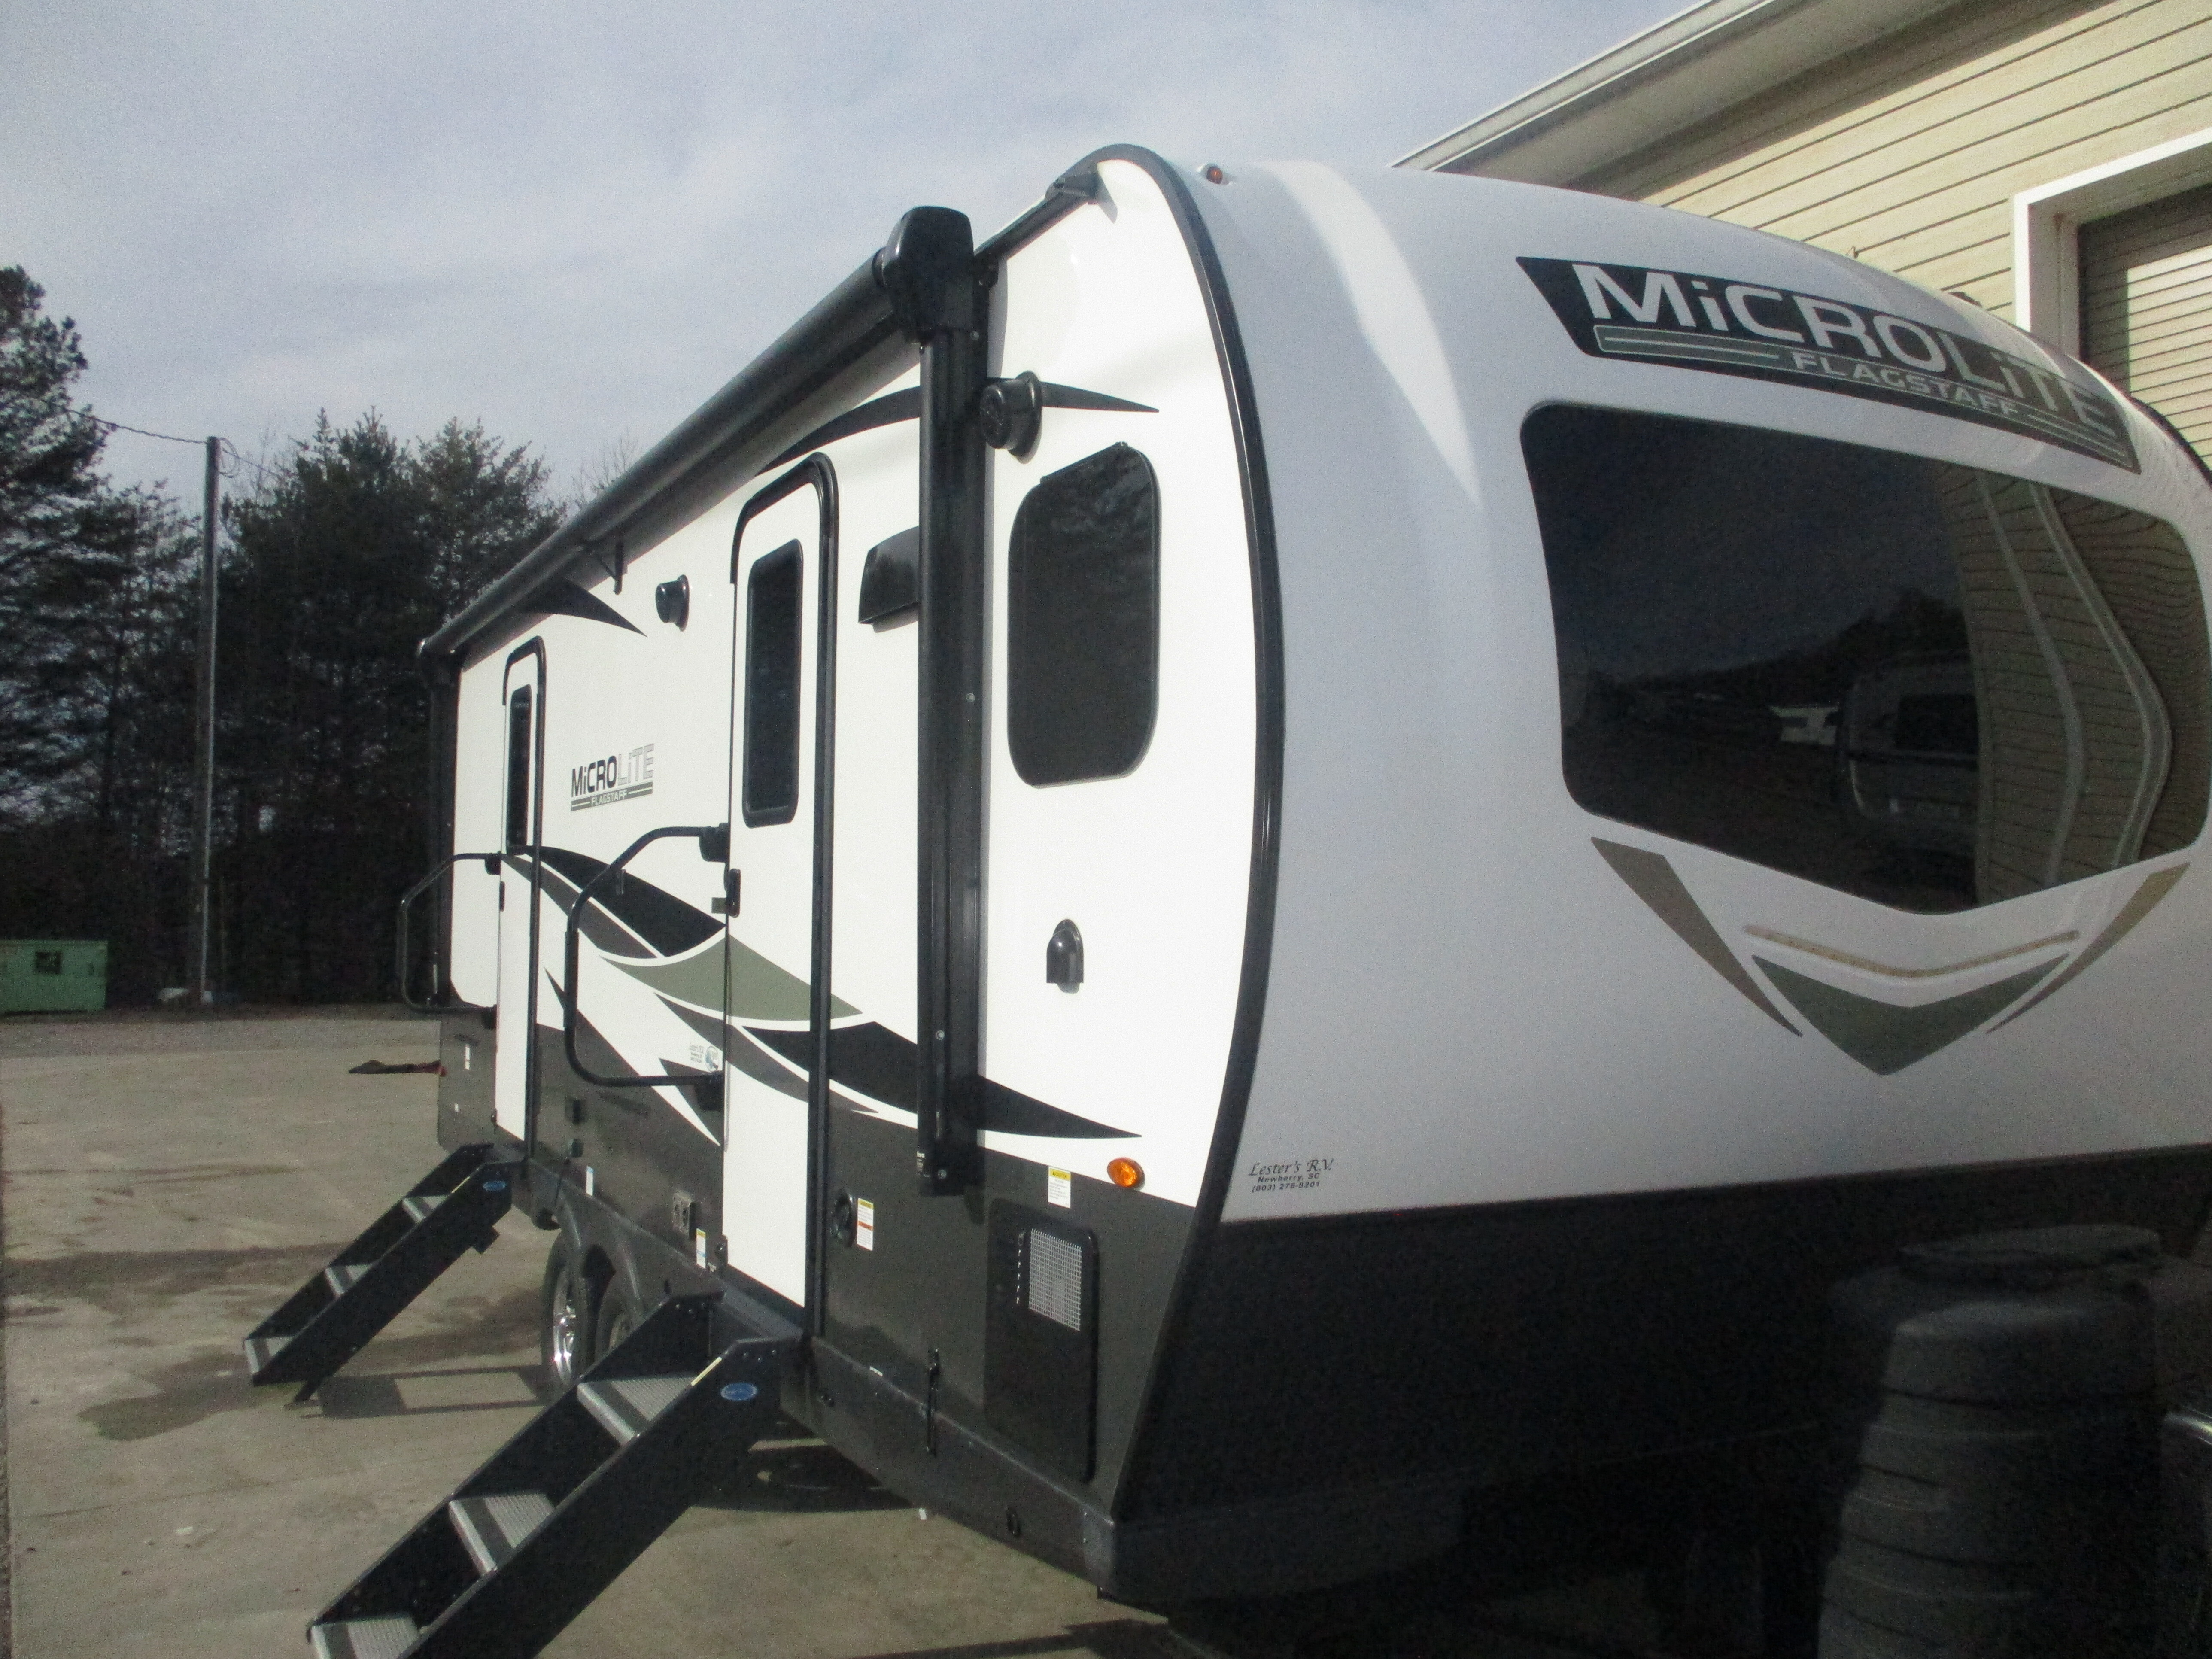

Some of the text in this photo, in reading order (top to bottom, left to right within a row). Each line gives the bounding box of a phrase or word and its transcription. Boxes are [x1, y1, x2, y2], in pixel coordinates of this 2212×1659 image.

[1793, 351, 2021, 417] FLAGSTAFF
[590, 789, 628, 806] FLAGSTAFF
[1248, 1160, 1301, 1176] Lester's
[1252, 1184, 1276, 1193] (803)
